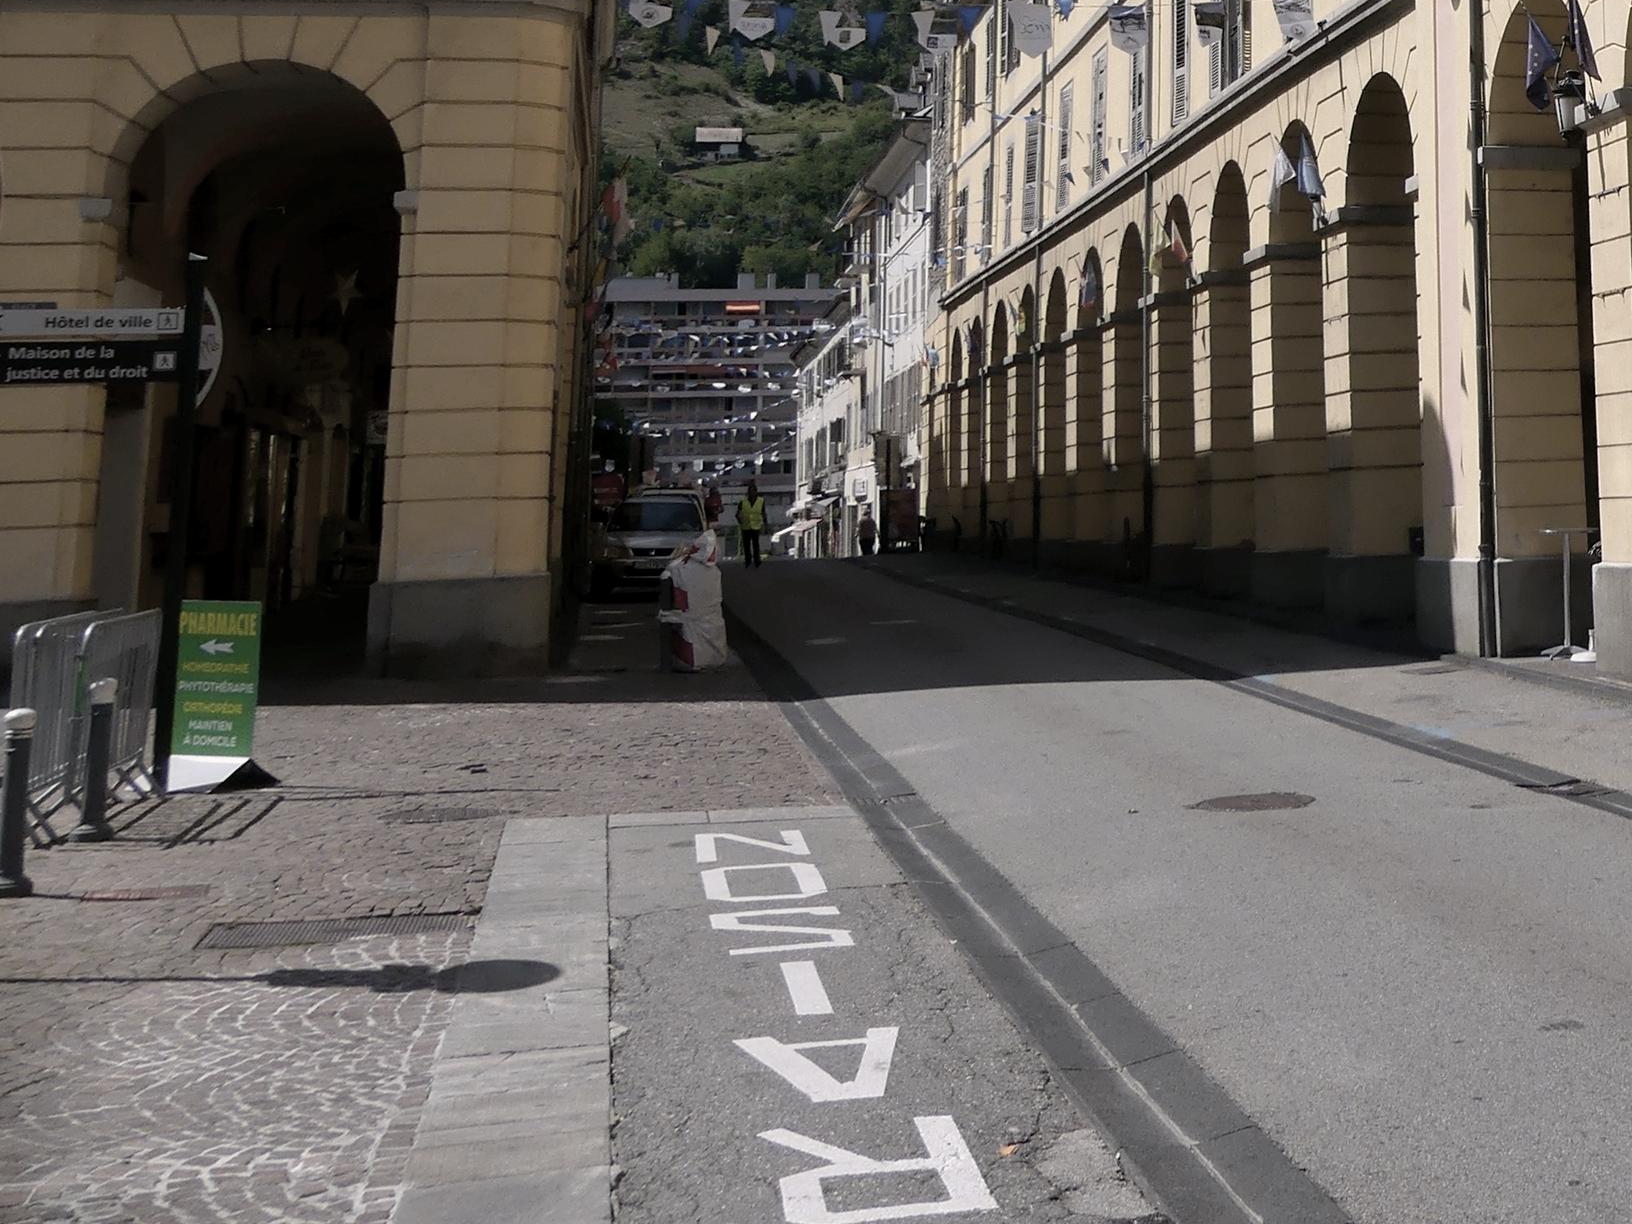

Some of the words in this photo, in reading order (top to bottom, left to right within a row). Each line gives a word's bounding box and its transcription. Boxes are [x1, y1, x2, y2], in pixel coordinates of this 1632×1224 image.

[45, 315, 89, 329] Hôtel
[96, 316, 114, 328] de
[119, 316, 152, 328] ville
[8, 346, 70, 360] Maison
[75, 346, 95, 359] de
[101, 345, 115, 359] la
[6, 367, 59, 383] justice
[64, 367, 80, 379] et
[84, 366, 104, 378] du
[109, 364, 148, 378] droit
[179, 611, 257, 635] PHARMACIE
[188, 719, 233, 732] MAINTIEN
[192, 735, 237, 747] DOMICILE
